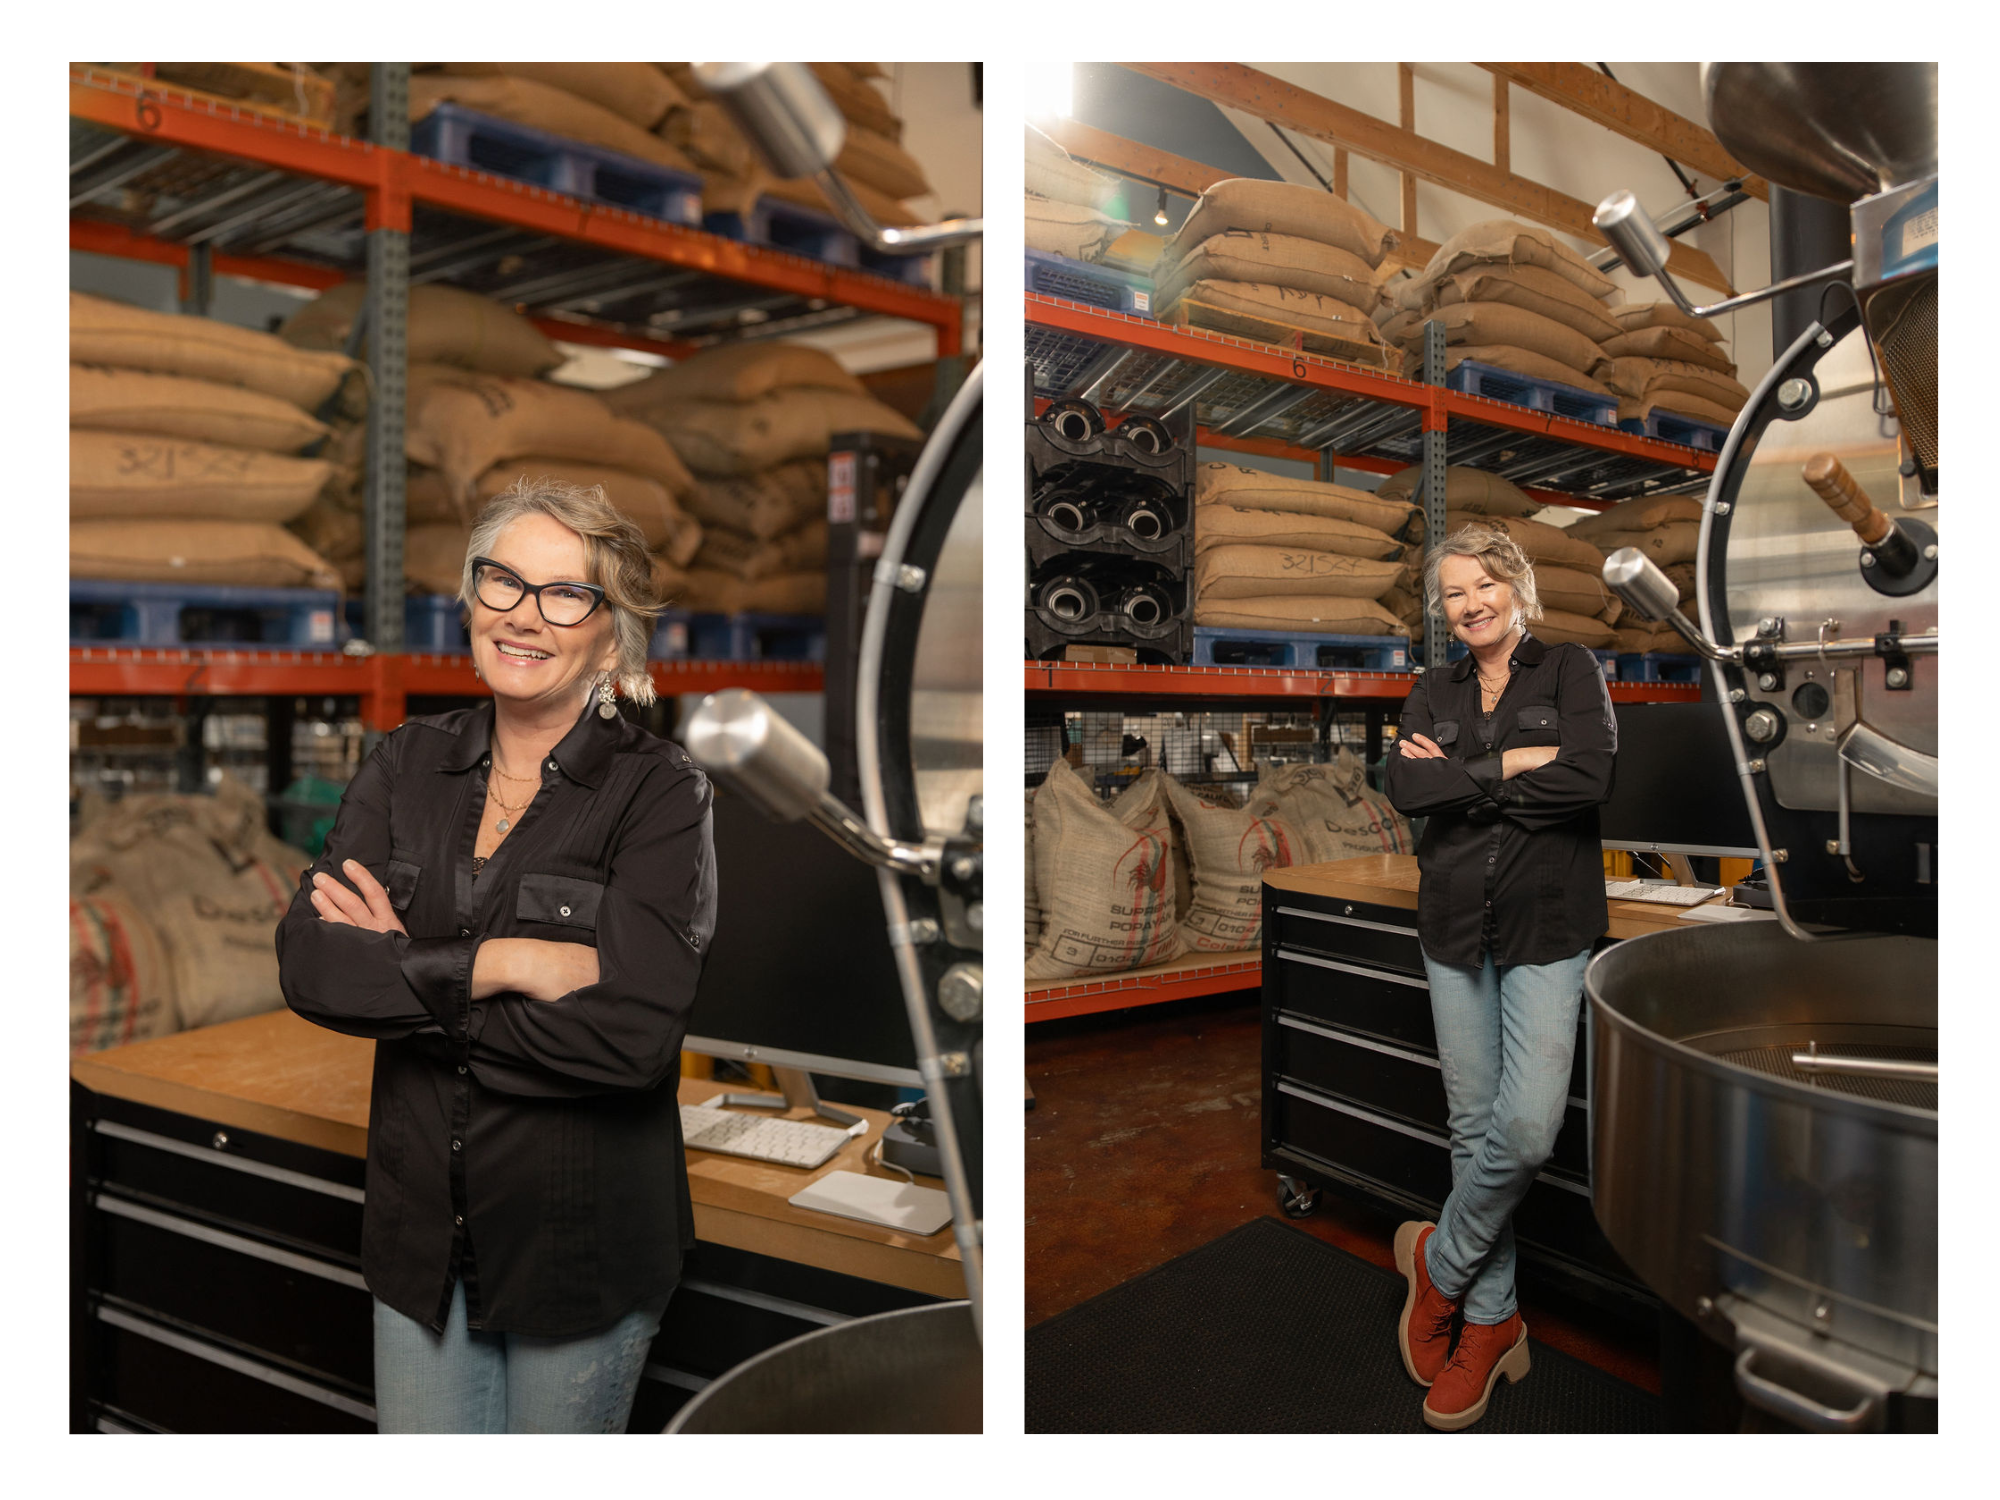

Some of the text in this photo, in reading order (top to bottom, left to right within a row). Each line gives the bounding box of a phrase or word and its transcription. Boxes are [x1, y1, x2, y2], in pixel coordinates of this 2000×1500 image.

[135, 89, 162, 131] 6
[1293, 356, 1306, 378] 6
[1062, 928, 1081, 938] FOR
